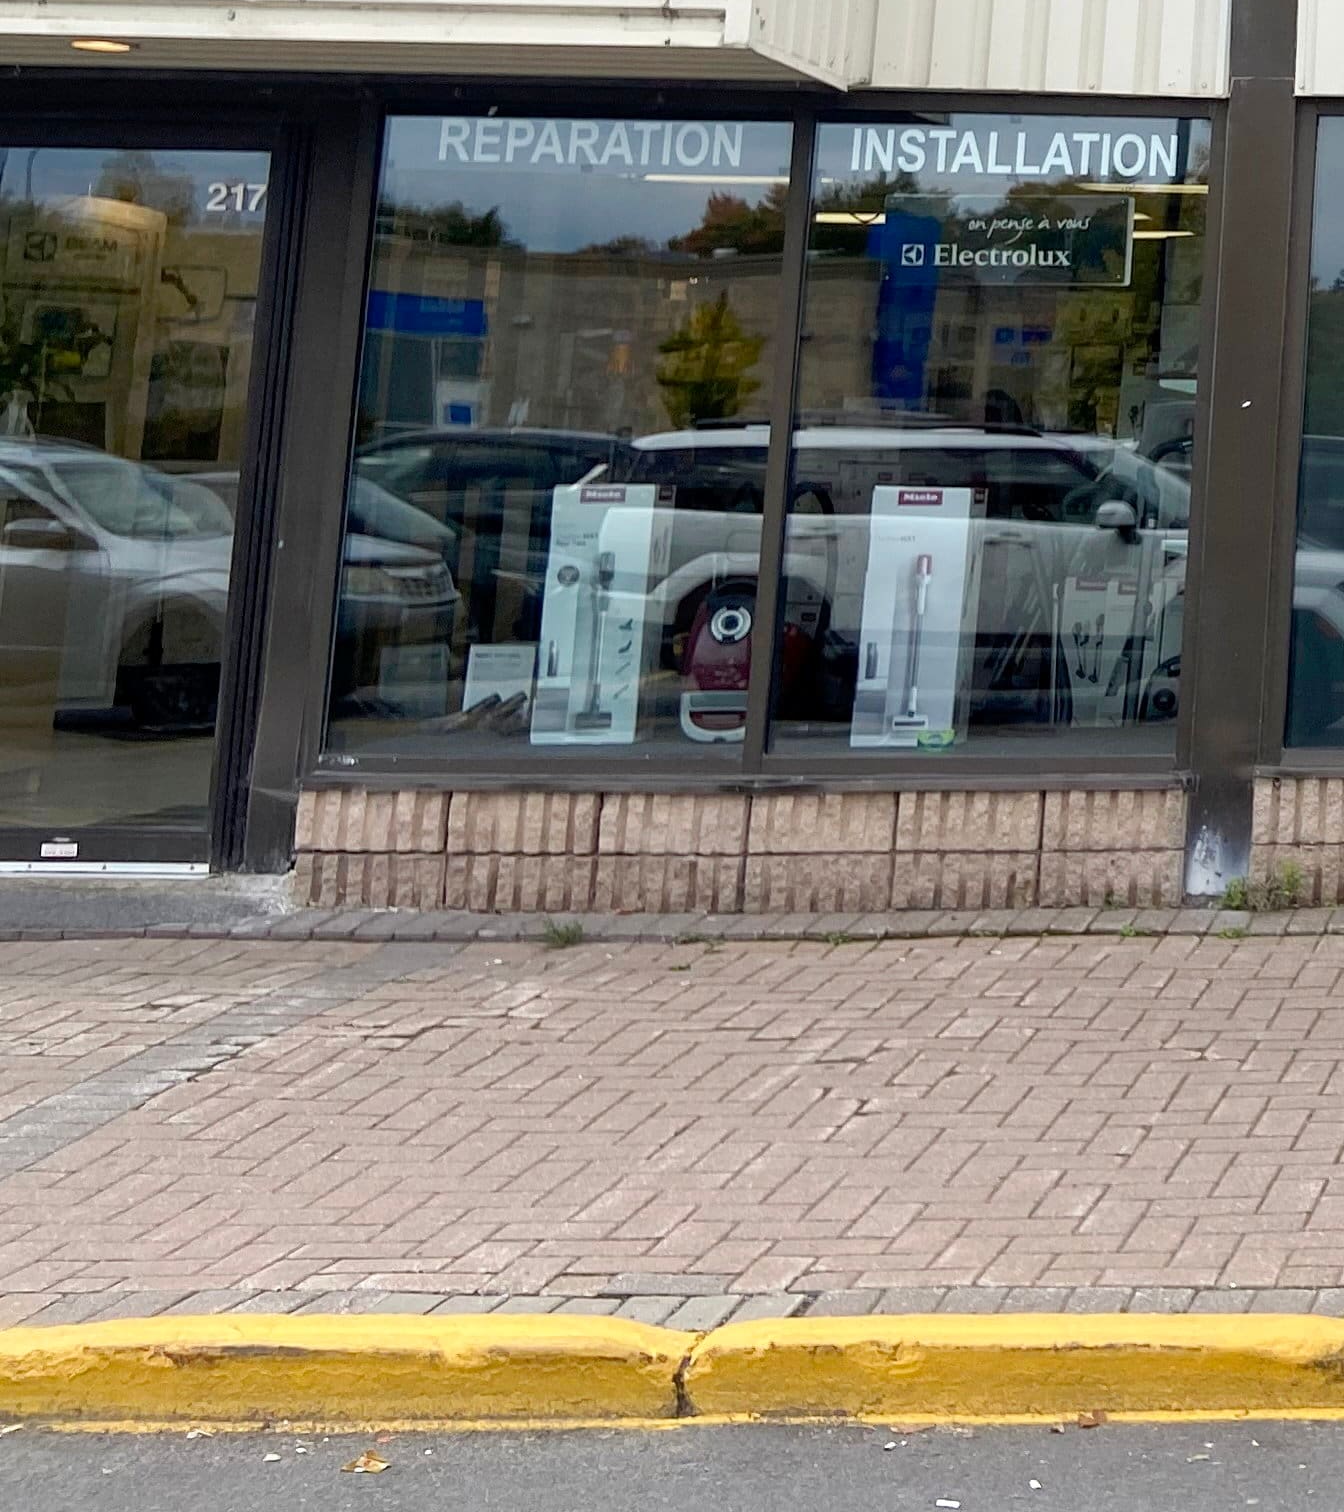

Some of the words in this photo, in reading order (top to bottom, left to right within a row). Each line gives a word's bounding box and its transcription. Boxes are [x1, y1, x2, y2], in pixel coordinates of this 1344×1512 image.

[438, 106, 744, 167] RÉPARATION
[850, 127, 1179, 177] INSTALLATION
[206, 182, 268, 212] 217
[968, 220, 987, 231] on
[986, 217, 1034, 245] pense
[1038, 214, 1050, 230] à
[1057, 216, 1091, 231] vous
[933, 244, 1072, 267] Electrolux
